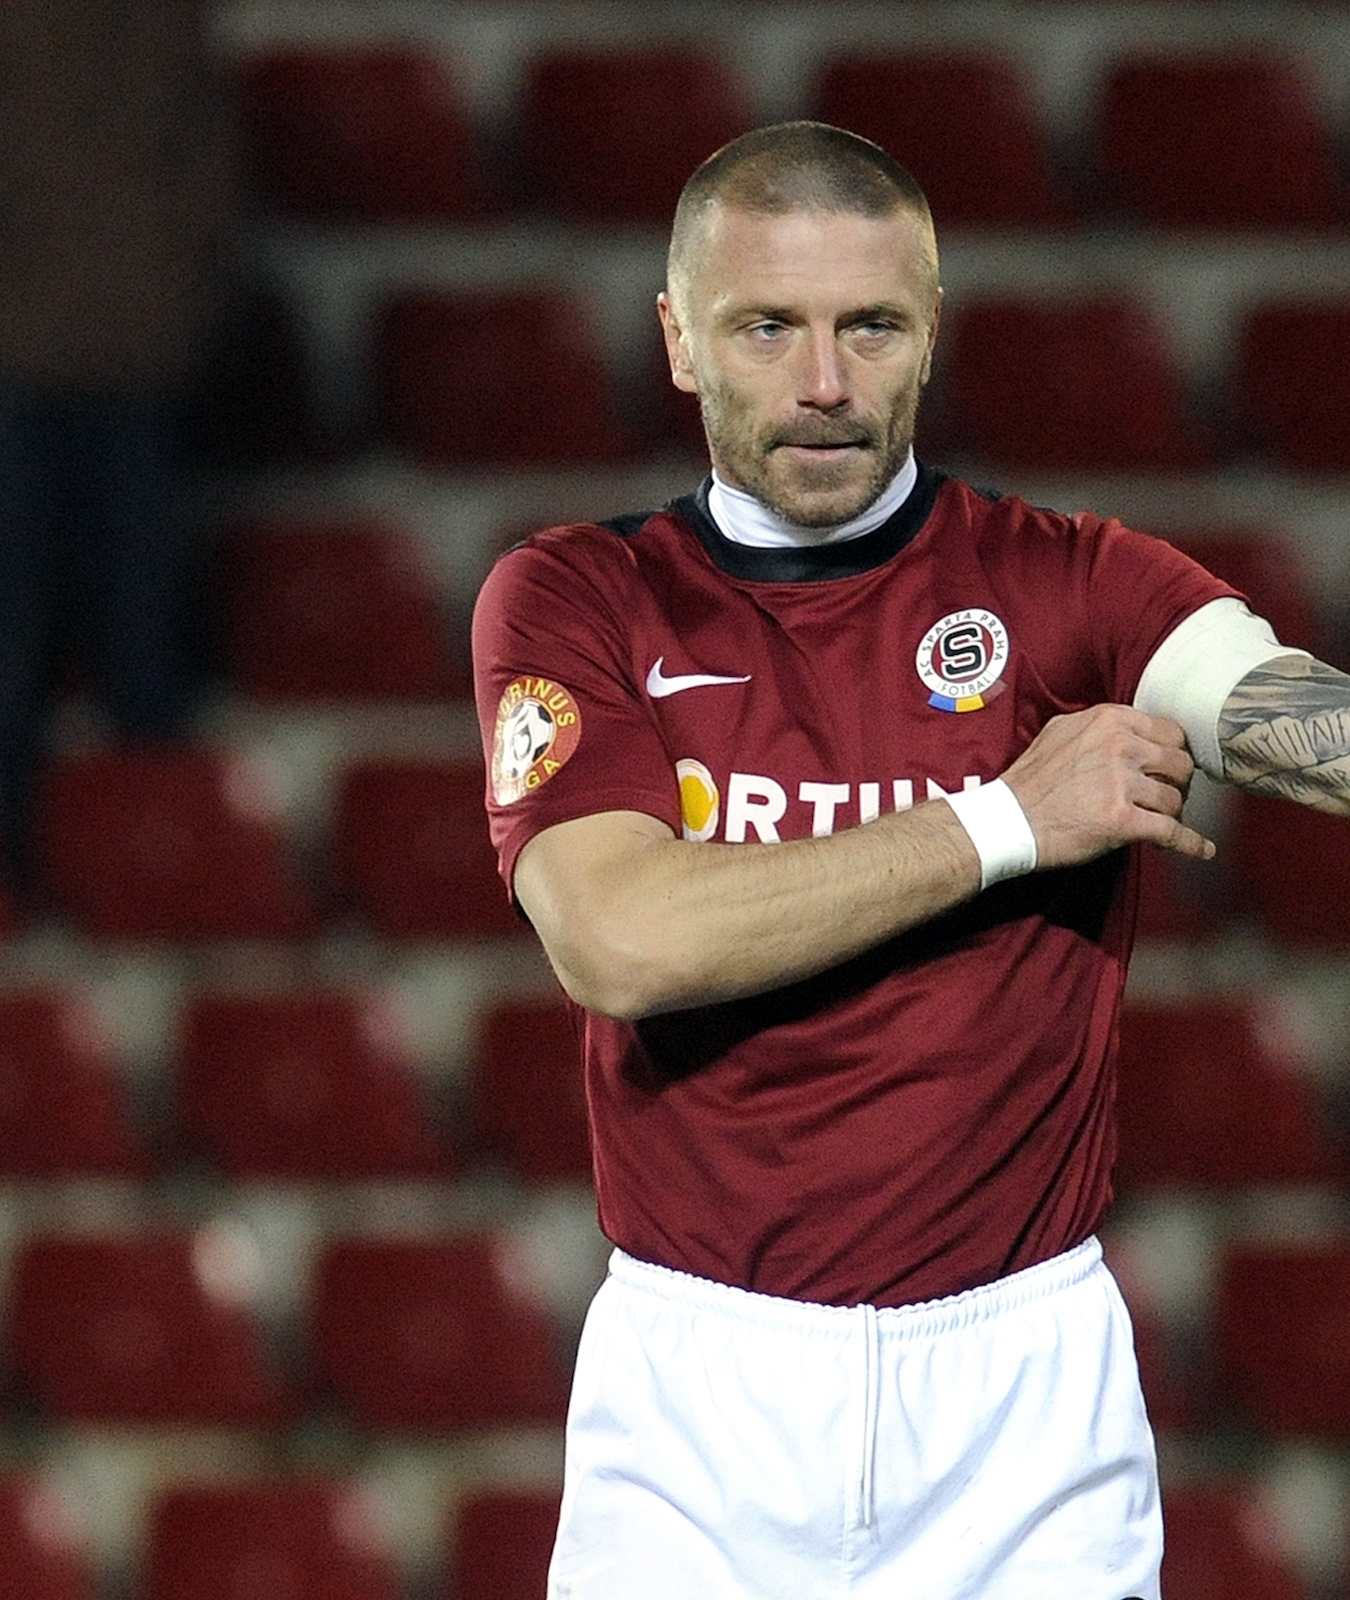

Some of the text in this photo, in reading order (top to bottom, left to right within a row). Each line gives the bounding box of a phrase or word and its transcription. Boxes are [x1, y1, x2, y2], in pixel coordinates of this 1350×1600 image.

[922, 612, 972, 651] SPARTA
[979, 613, 1005, 661] PRAHA
[943, 627, 982, 675] S
[940, 676, 991, 696] FOTBAL
